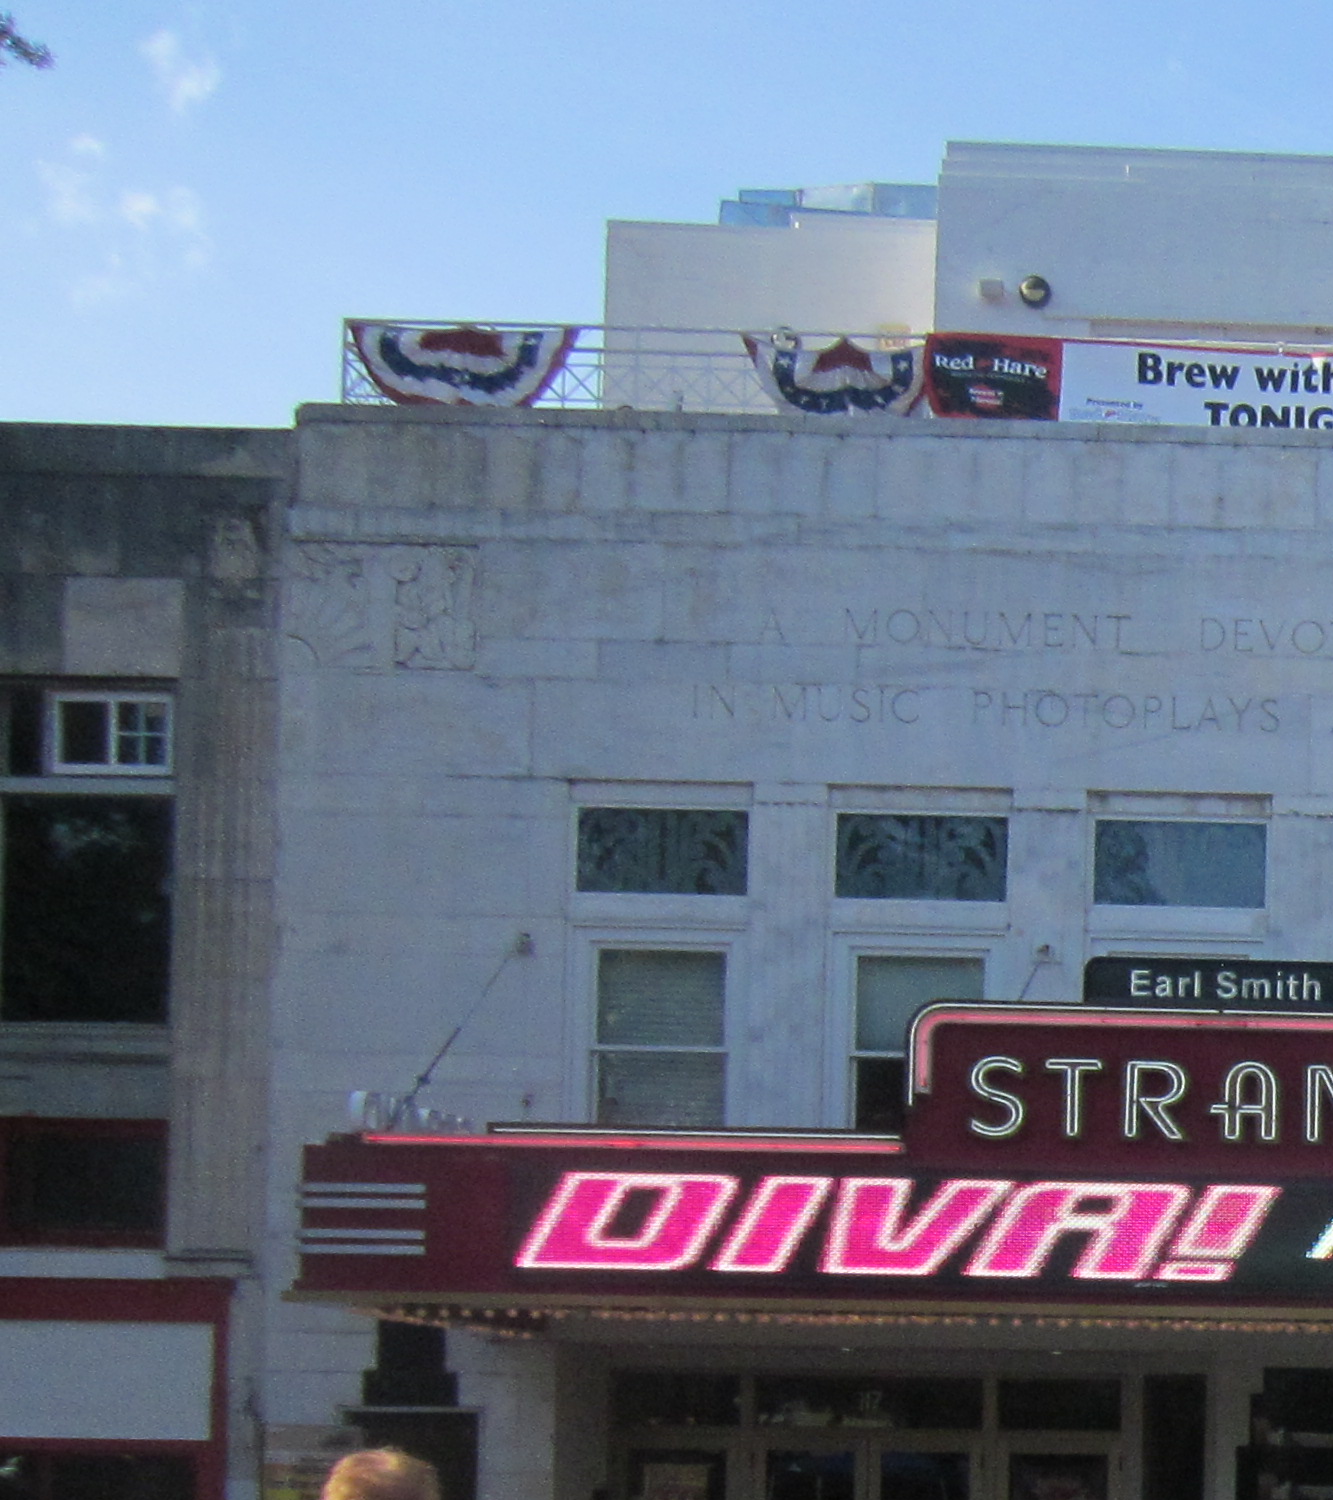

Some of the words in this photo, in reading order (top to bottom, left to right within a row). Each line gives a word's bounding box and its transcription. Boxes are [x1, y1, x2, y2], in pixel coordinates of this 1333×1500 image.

[934, 353, 974, 370] Red
[993, 358, 1047, 379] Hare
[1137, 352, 1240, 390] Brew
[759, 608, 785, 642] A
[843, 607, 1132, 651] MONUMENT
[692, 684, 735, 720] IN
[771, 684, 920, 725] MUSIC
[971, 688, 1280, 733] PHOTOPLAYS
[1130, 969, 1201, 997] Earl
[1215, 971, 1323, 1000] Smith
[515, 1171, 1277, 1281] DIVA!
